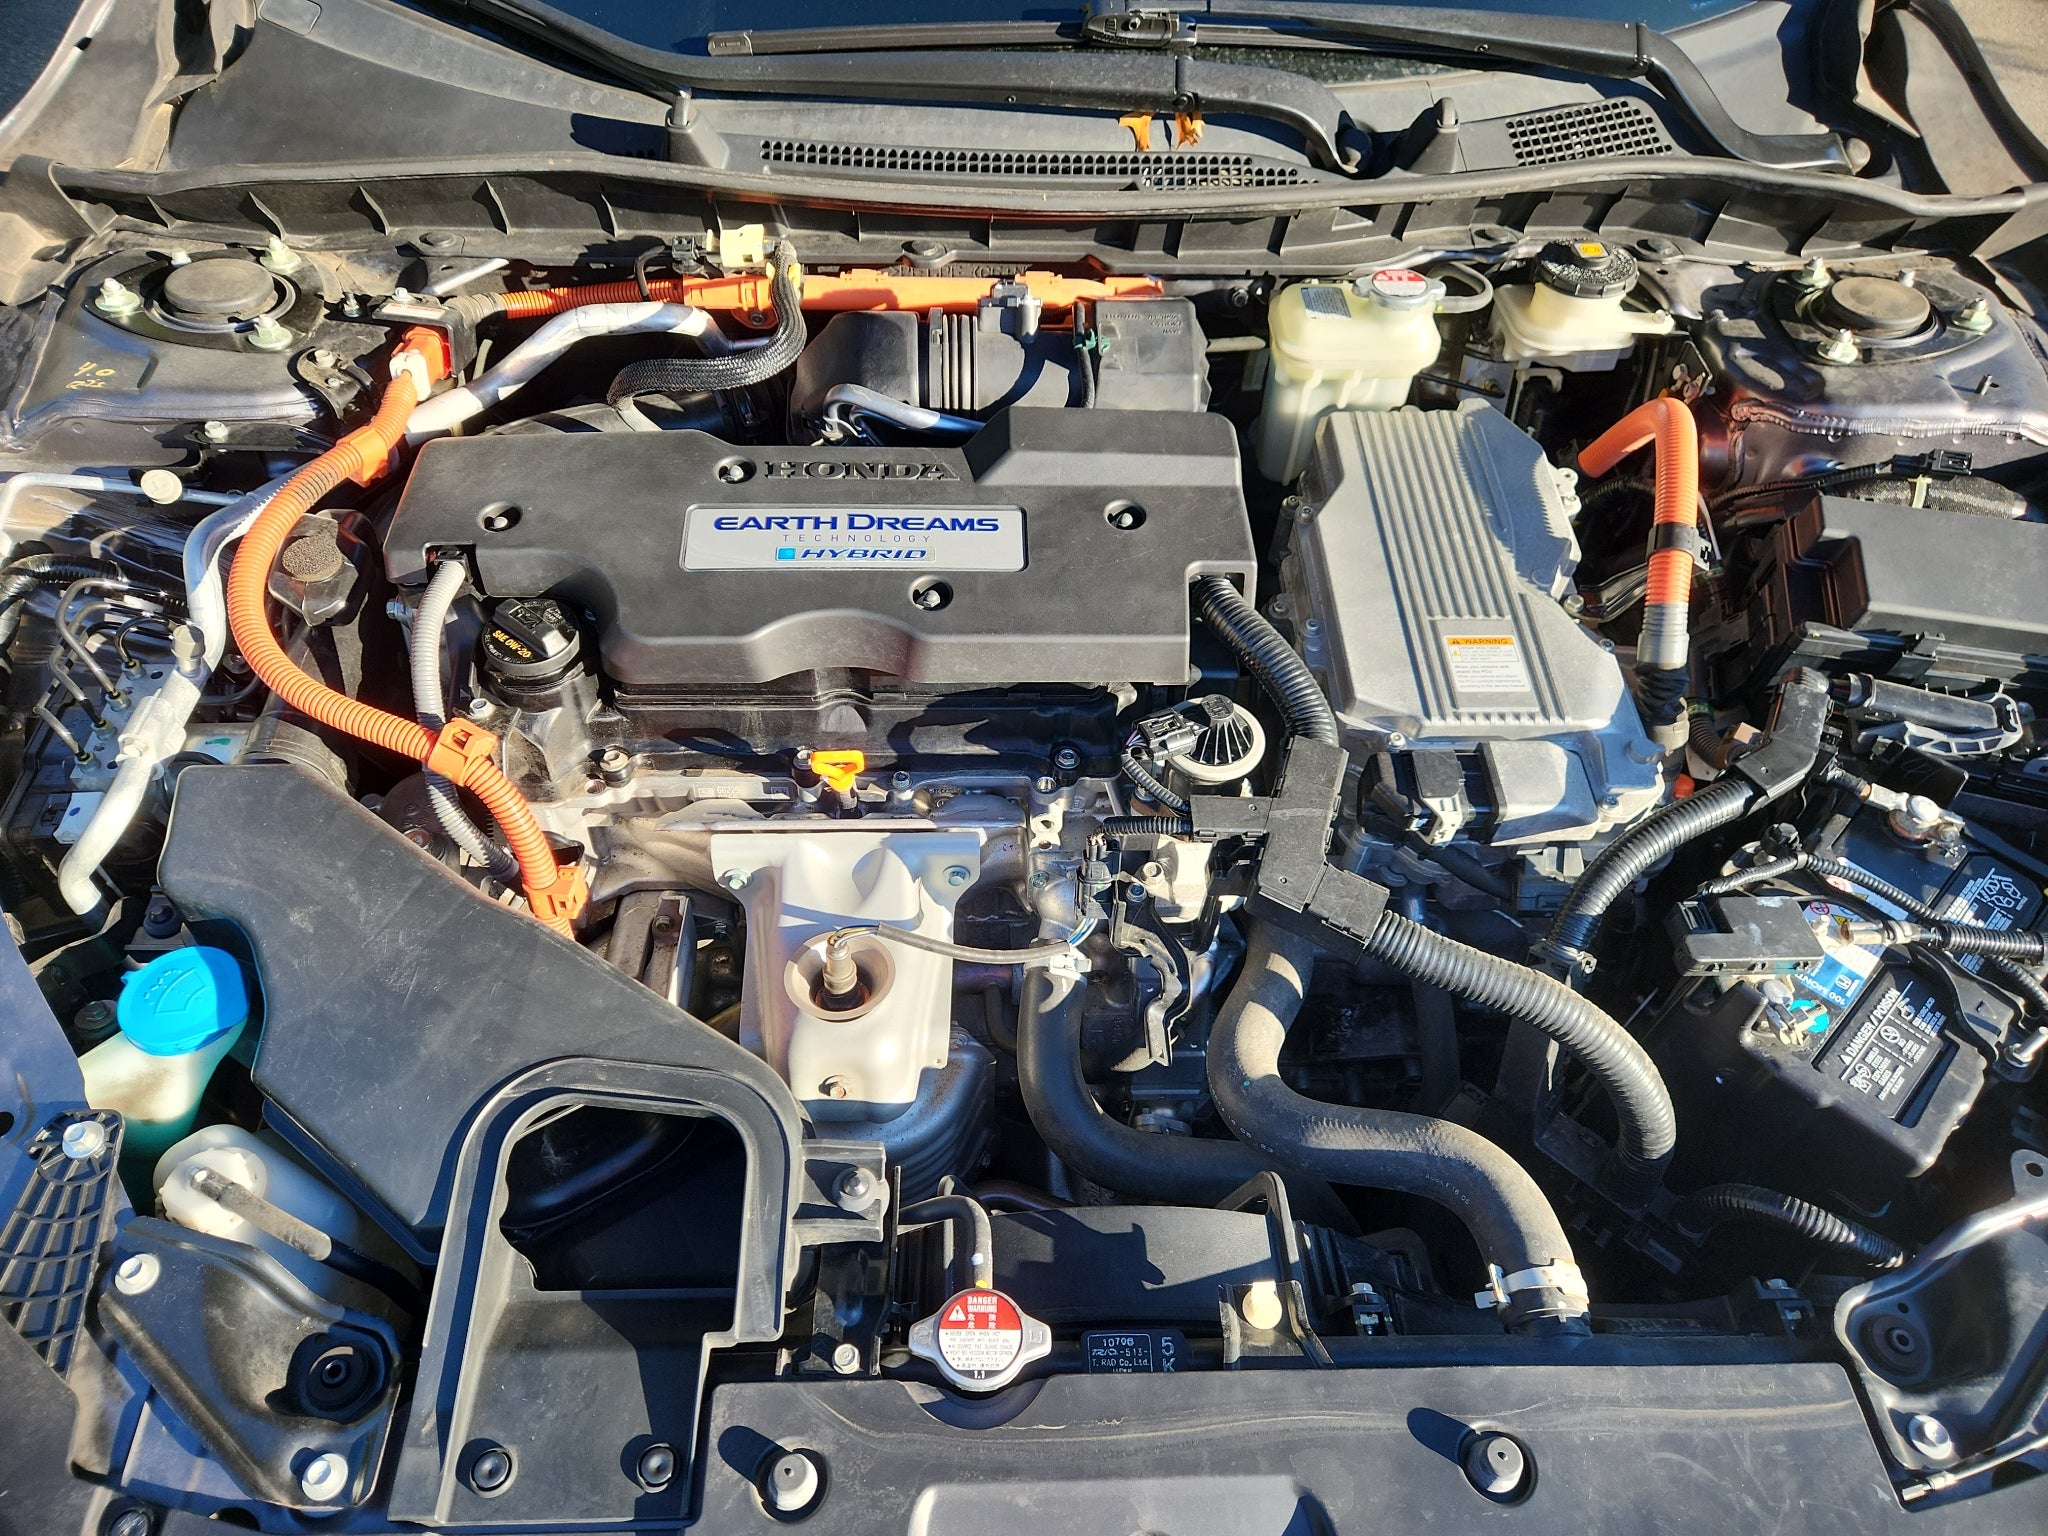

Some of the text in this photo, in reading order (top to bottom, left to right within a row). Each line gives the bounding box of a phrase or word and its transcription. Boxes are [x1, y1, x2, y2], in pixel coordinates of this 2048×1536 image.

[764, 460, 960, 481] HONDA
[713, 513, 1000, 532] EARTH DREAMS
[783, 533, 932, 543] TECHNOLOGY
[800, 548, 927, 560] HYBRID
[492, 630, 508, 643] SAE
[1795, 973, 1829, 996] MONT
[1829, 992, 1846, 1005] 100
[1845, 1022, 1876, 1057] DANGER
[1873, 988, 1901, 1020] POISON
[967, 1296, 997, 1305] DANGER
[1161, 1336, 1175, 1356] 5
[973, 1370, 986, 1379] 1.1
